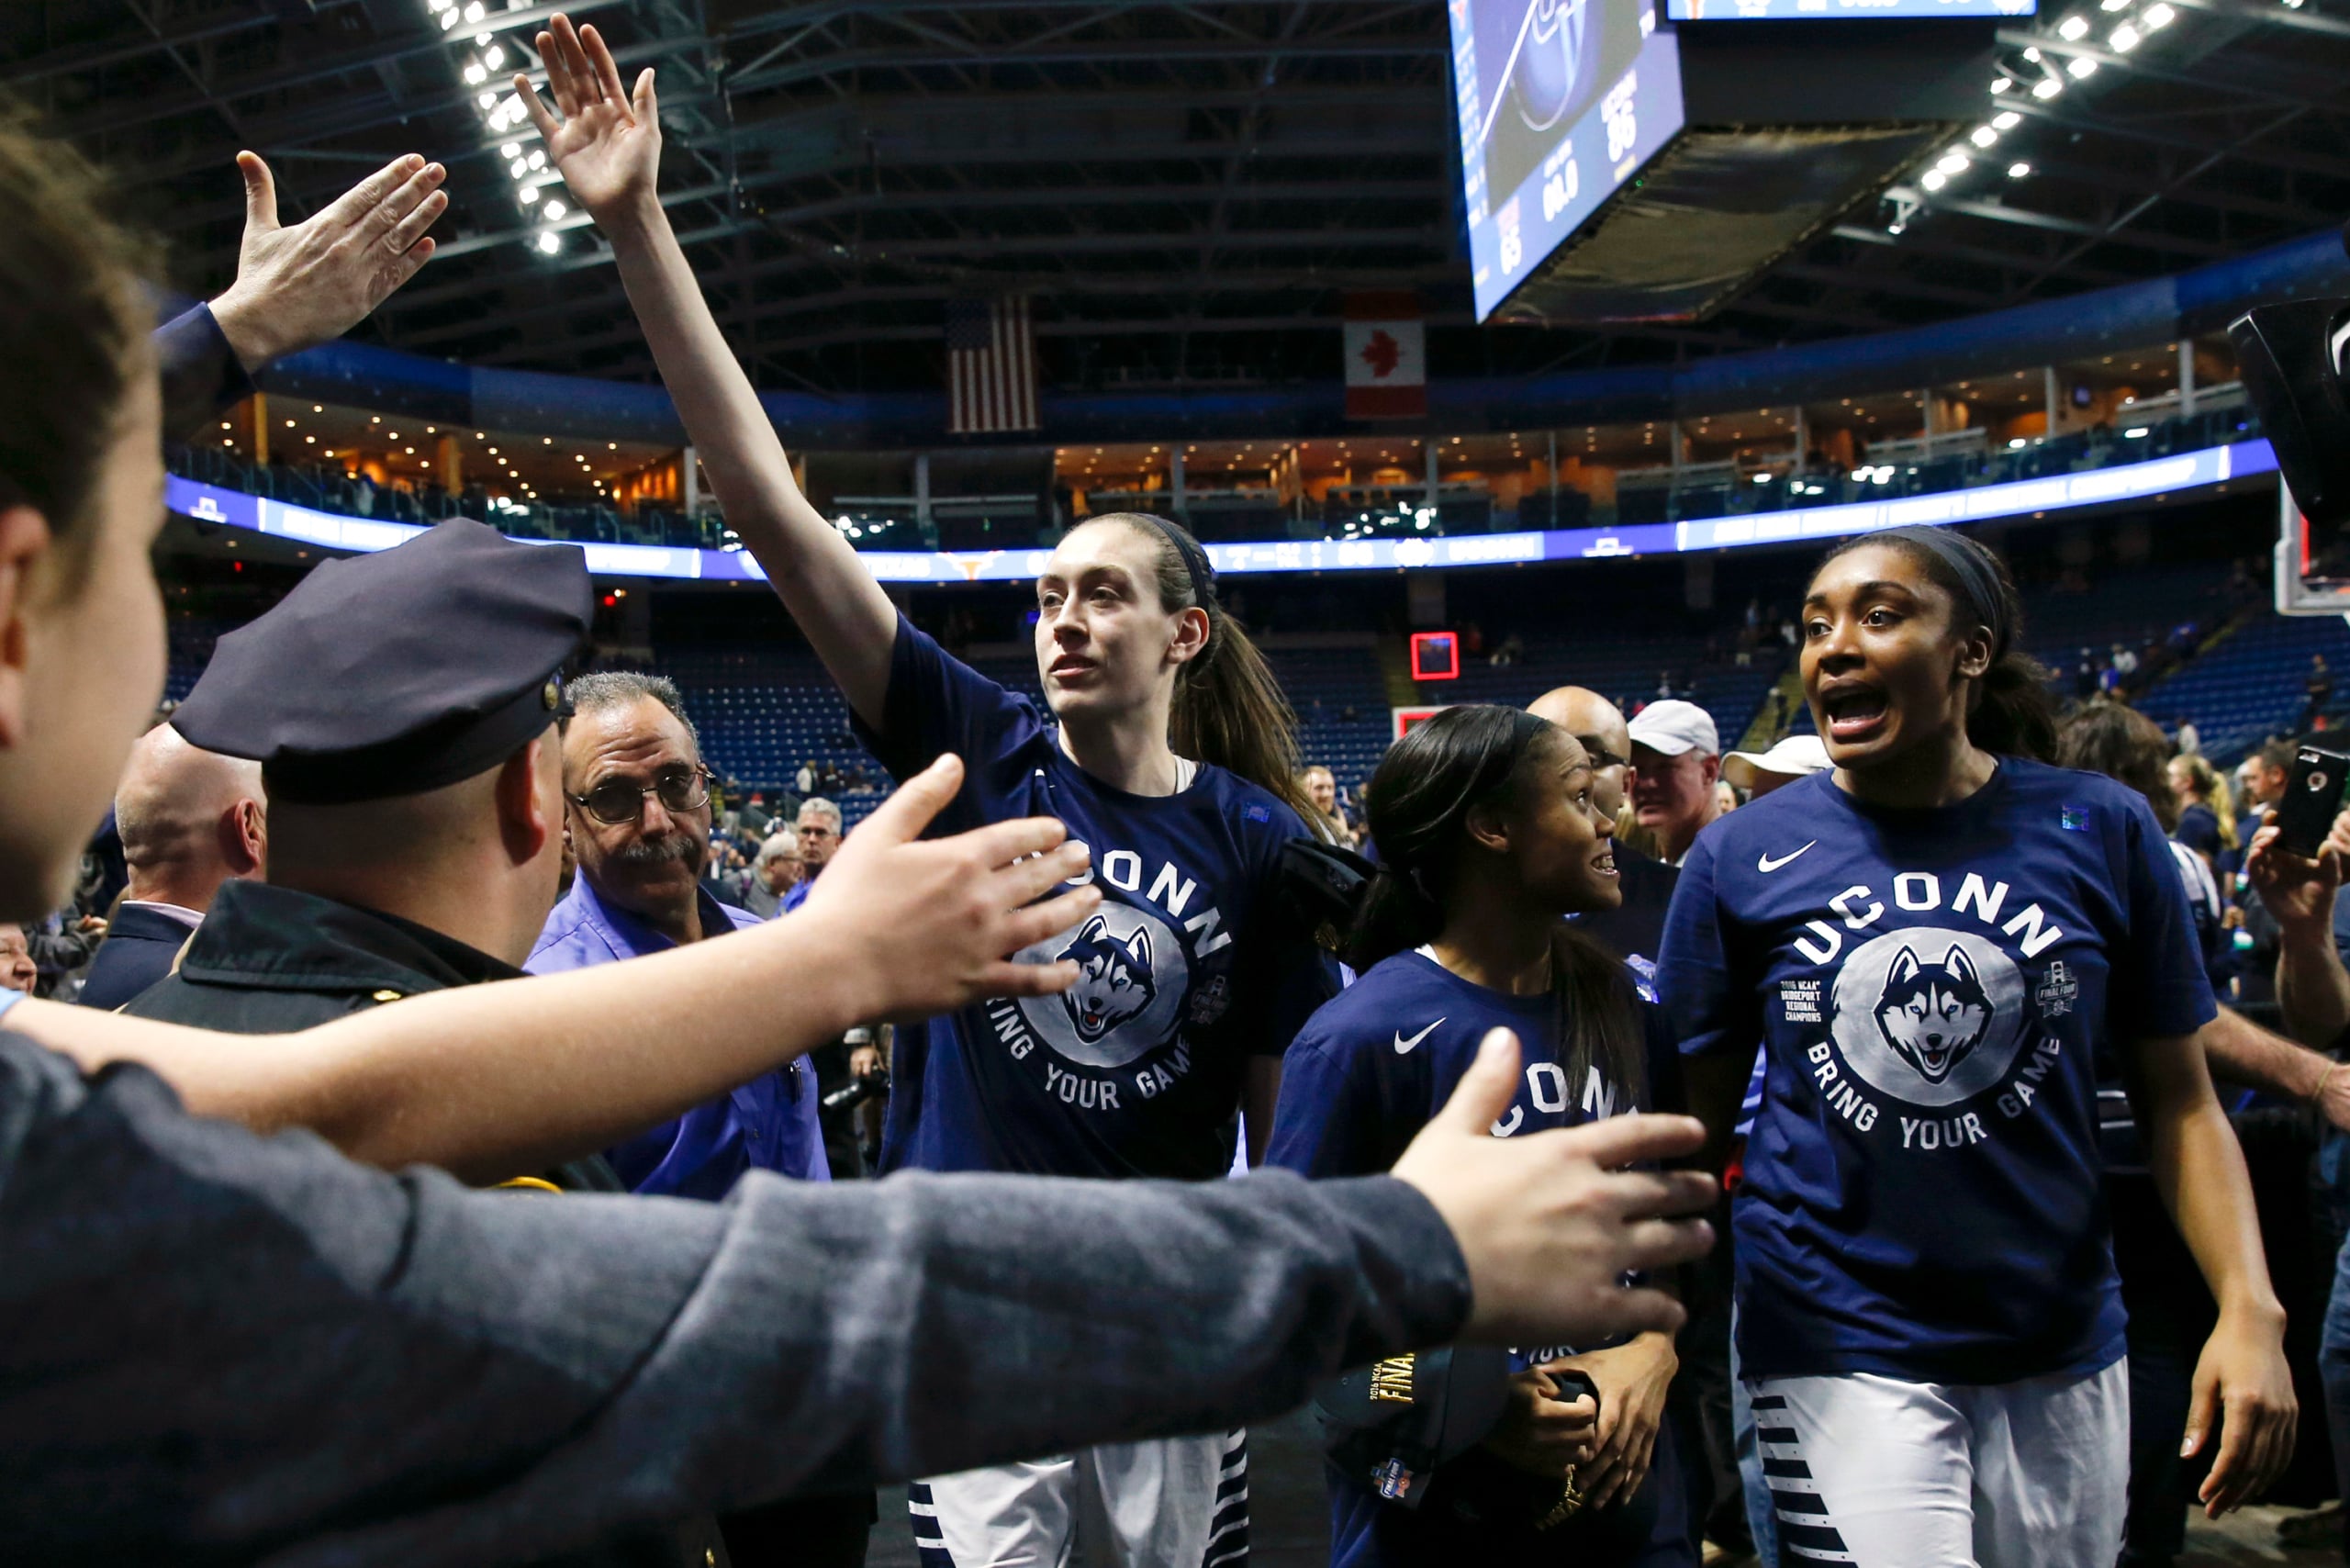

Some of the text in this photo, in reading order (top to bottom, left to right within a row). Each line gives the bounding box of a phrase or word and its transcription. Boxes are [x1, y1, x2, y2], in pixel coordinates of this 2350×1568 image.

[1012, 839, 1232, 958] CONN
[1793, 872, 2063, 966] UCONN
[986, 997, 1192, 1110] ING YOUR GAME
[1807, 1036, 2060, 1149] BRING YOUR GAME
[1370, 1383, 1381, 1401] 2016
